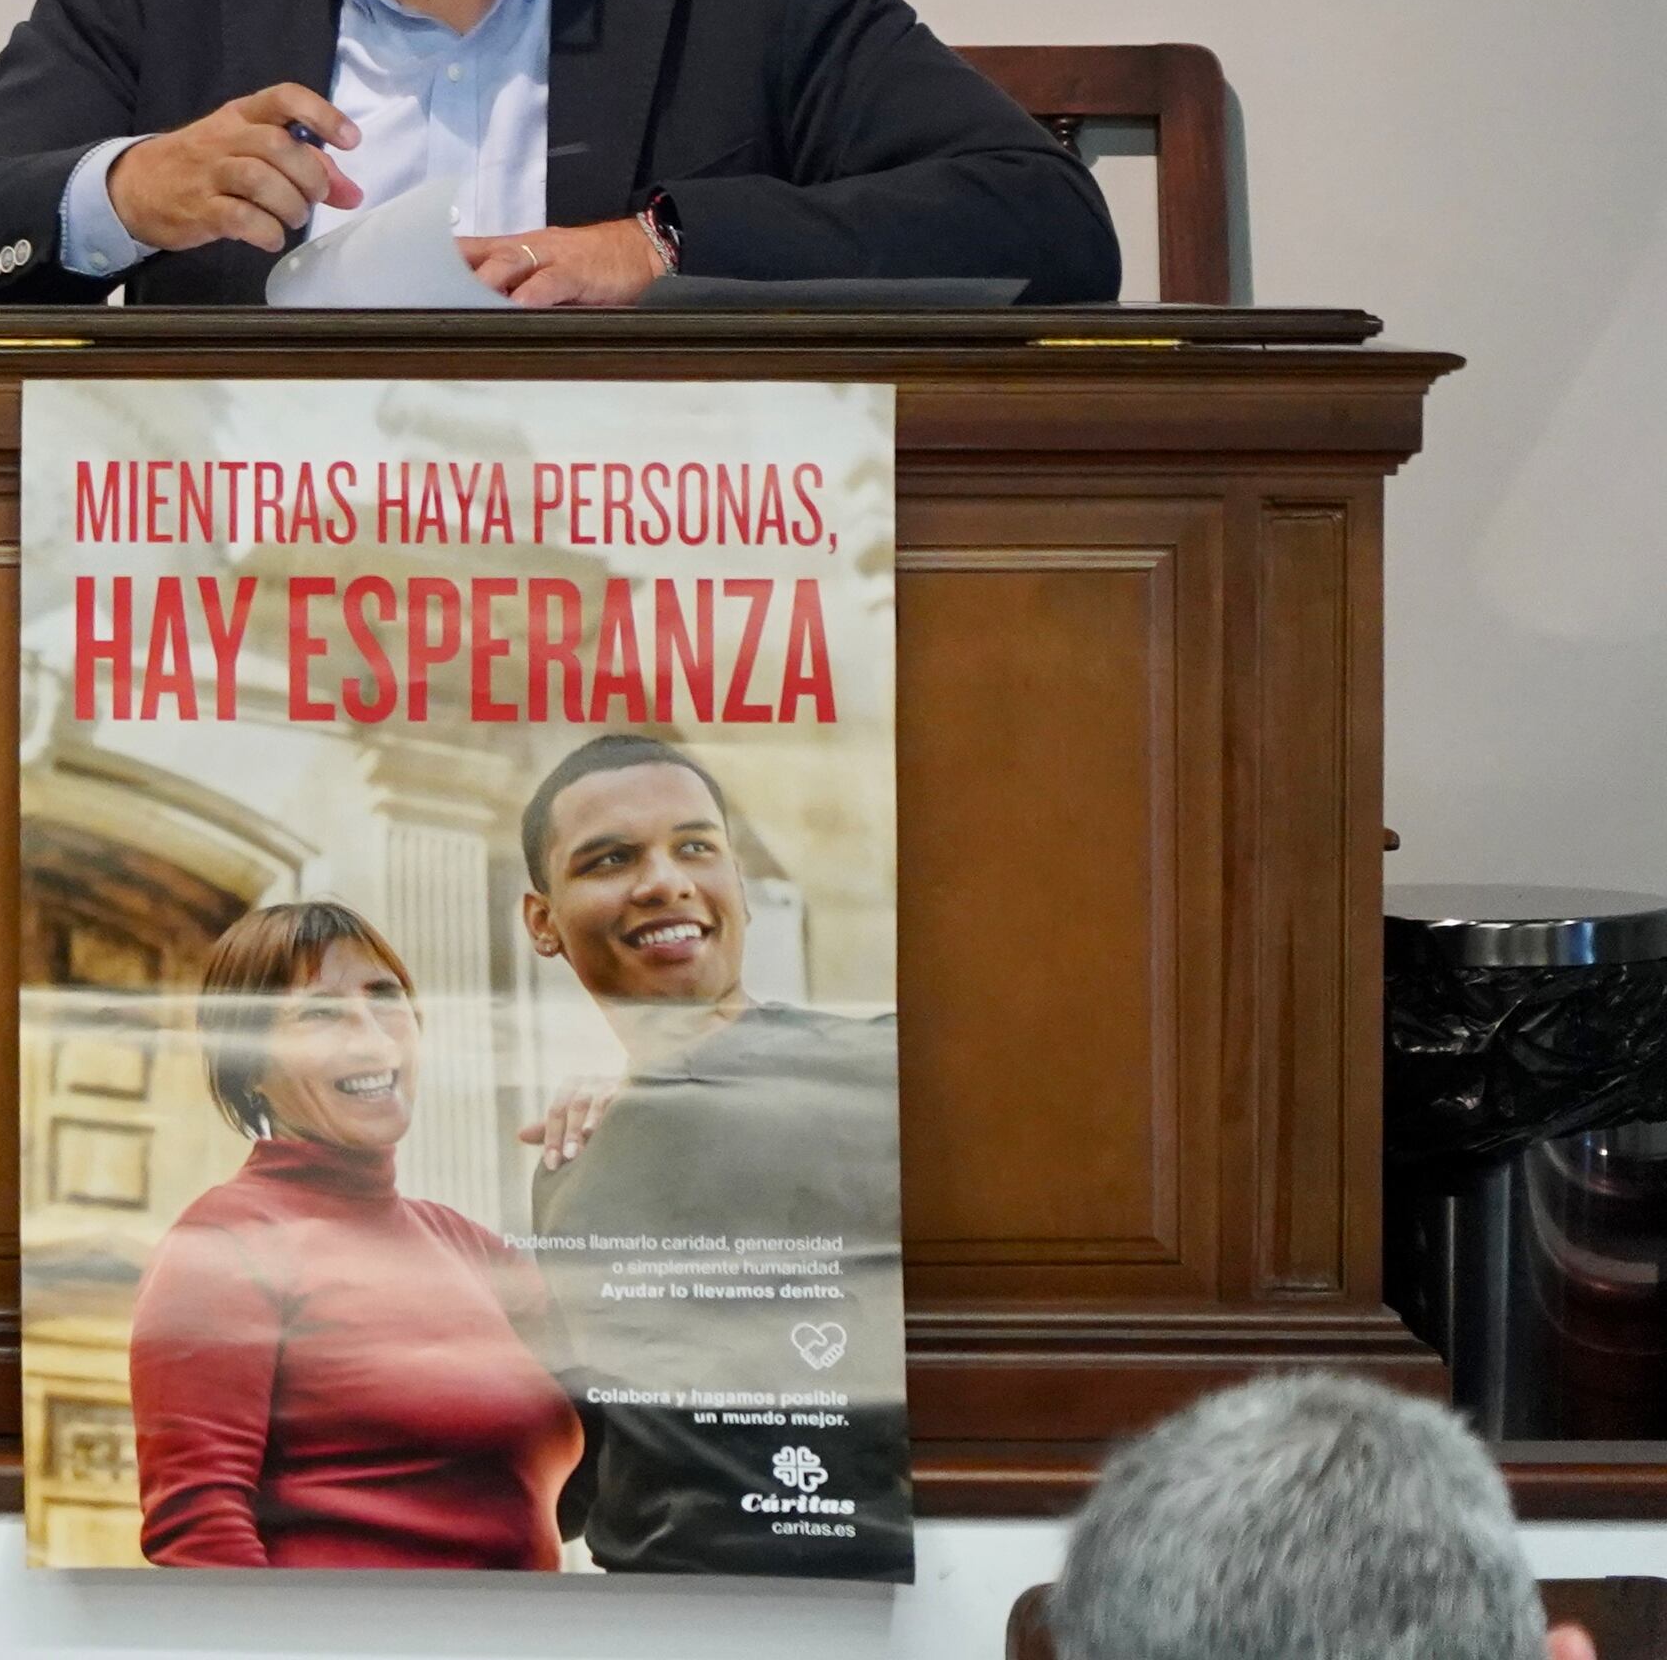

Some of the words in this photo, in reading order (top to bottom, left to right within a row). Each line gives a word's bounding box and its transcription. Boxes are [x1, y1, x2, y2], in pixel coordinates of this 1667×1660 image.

[75, 460, 358, 546] MIENTRAS
[377, 461, 515, 545] HAYA
[533, 461, 838, 554] PERSONAS,
[73, 575, 258, 722] HAY
[288, 575, 838, 725] ESPERANZA
[503, 1235, 586, 1251] Podemos
[590, 1235, 659, 1251] llamarlo
[662, 1235, 730, 1254] caridad,
[734, 1236, 842, 1255] generosidad
[612, 1262, 624, 1275] o
[628, 1259, 739, 1278] simplemente
[743, 1260, 843, 1276] humanidad.
[600, 1284, 665, 1302] Ayudar
[671, 1284, 688, 1298] lo
[693, 1284, 774, 1299] llevamos
[779, 1284, 845, 1299] dentro.
[587, 1387, 670, 1404] Colabora
[676, 1392, 687, 1407] y
[691, 1389, 775, 1408] hagamos
[780, 1389, 848, 1409] posible
[694, 1411, 717, 1423] un
[722, 1410, 786, 1425] mundo
[791, 1411, 849, 1429] mejor.
[741, 1493, 855, 1515] Cáritas
[772, 1520, 856, 1538] caritas.es
